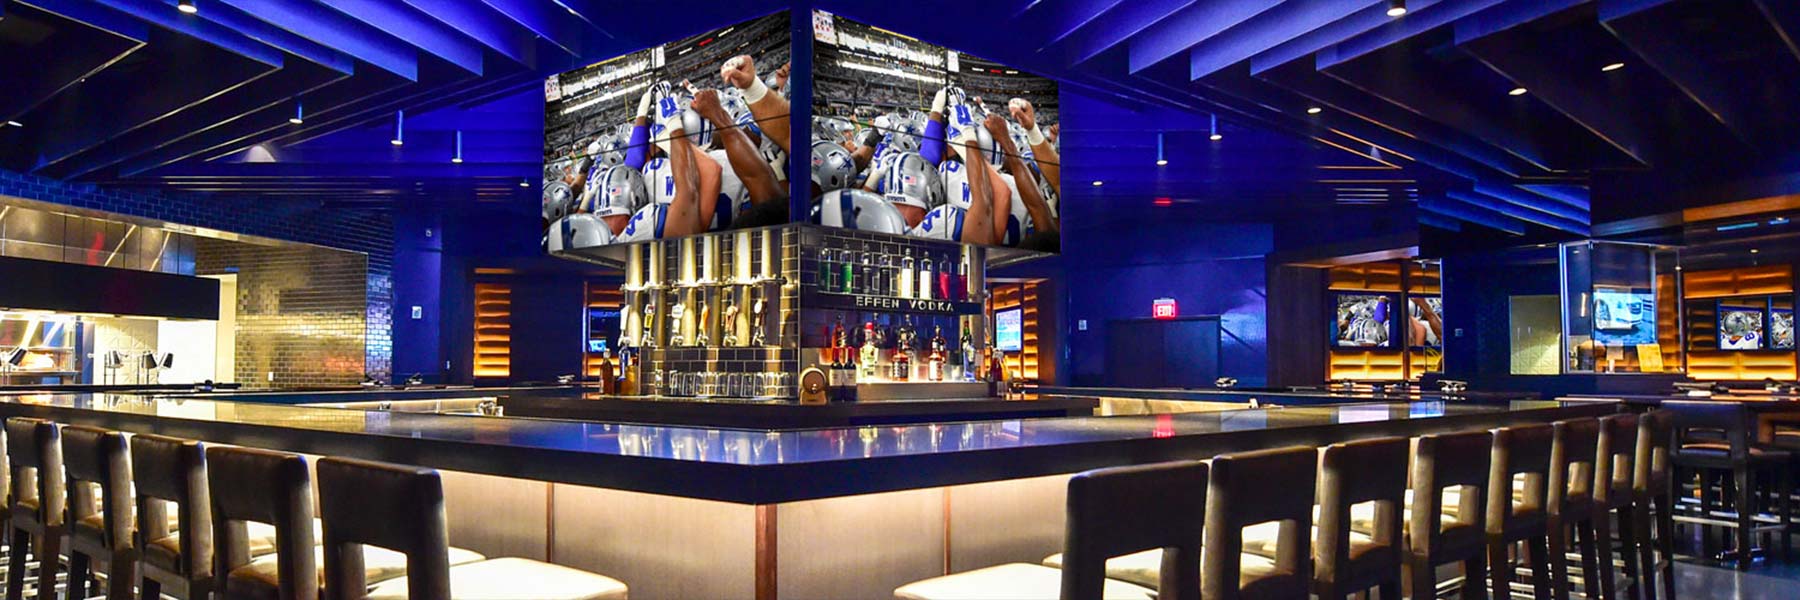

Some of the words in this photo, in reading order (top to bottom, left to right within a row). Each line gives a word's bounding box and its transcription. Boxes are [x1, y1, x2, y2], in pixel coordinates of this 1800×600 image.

[856, 296, 900, 308] EFFEN
[909, 299, 954, 312] VODKA
[1157, 305, 1172, 317] EXIT
